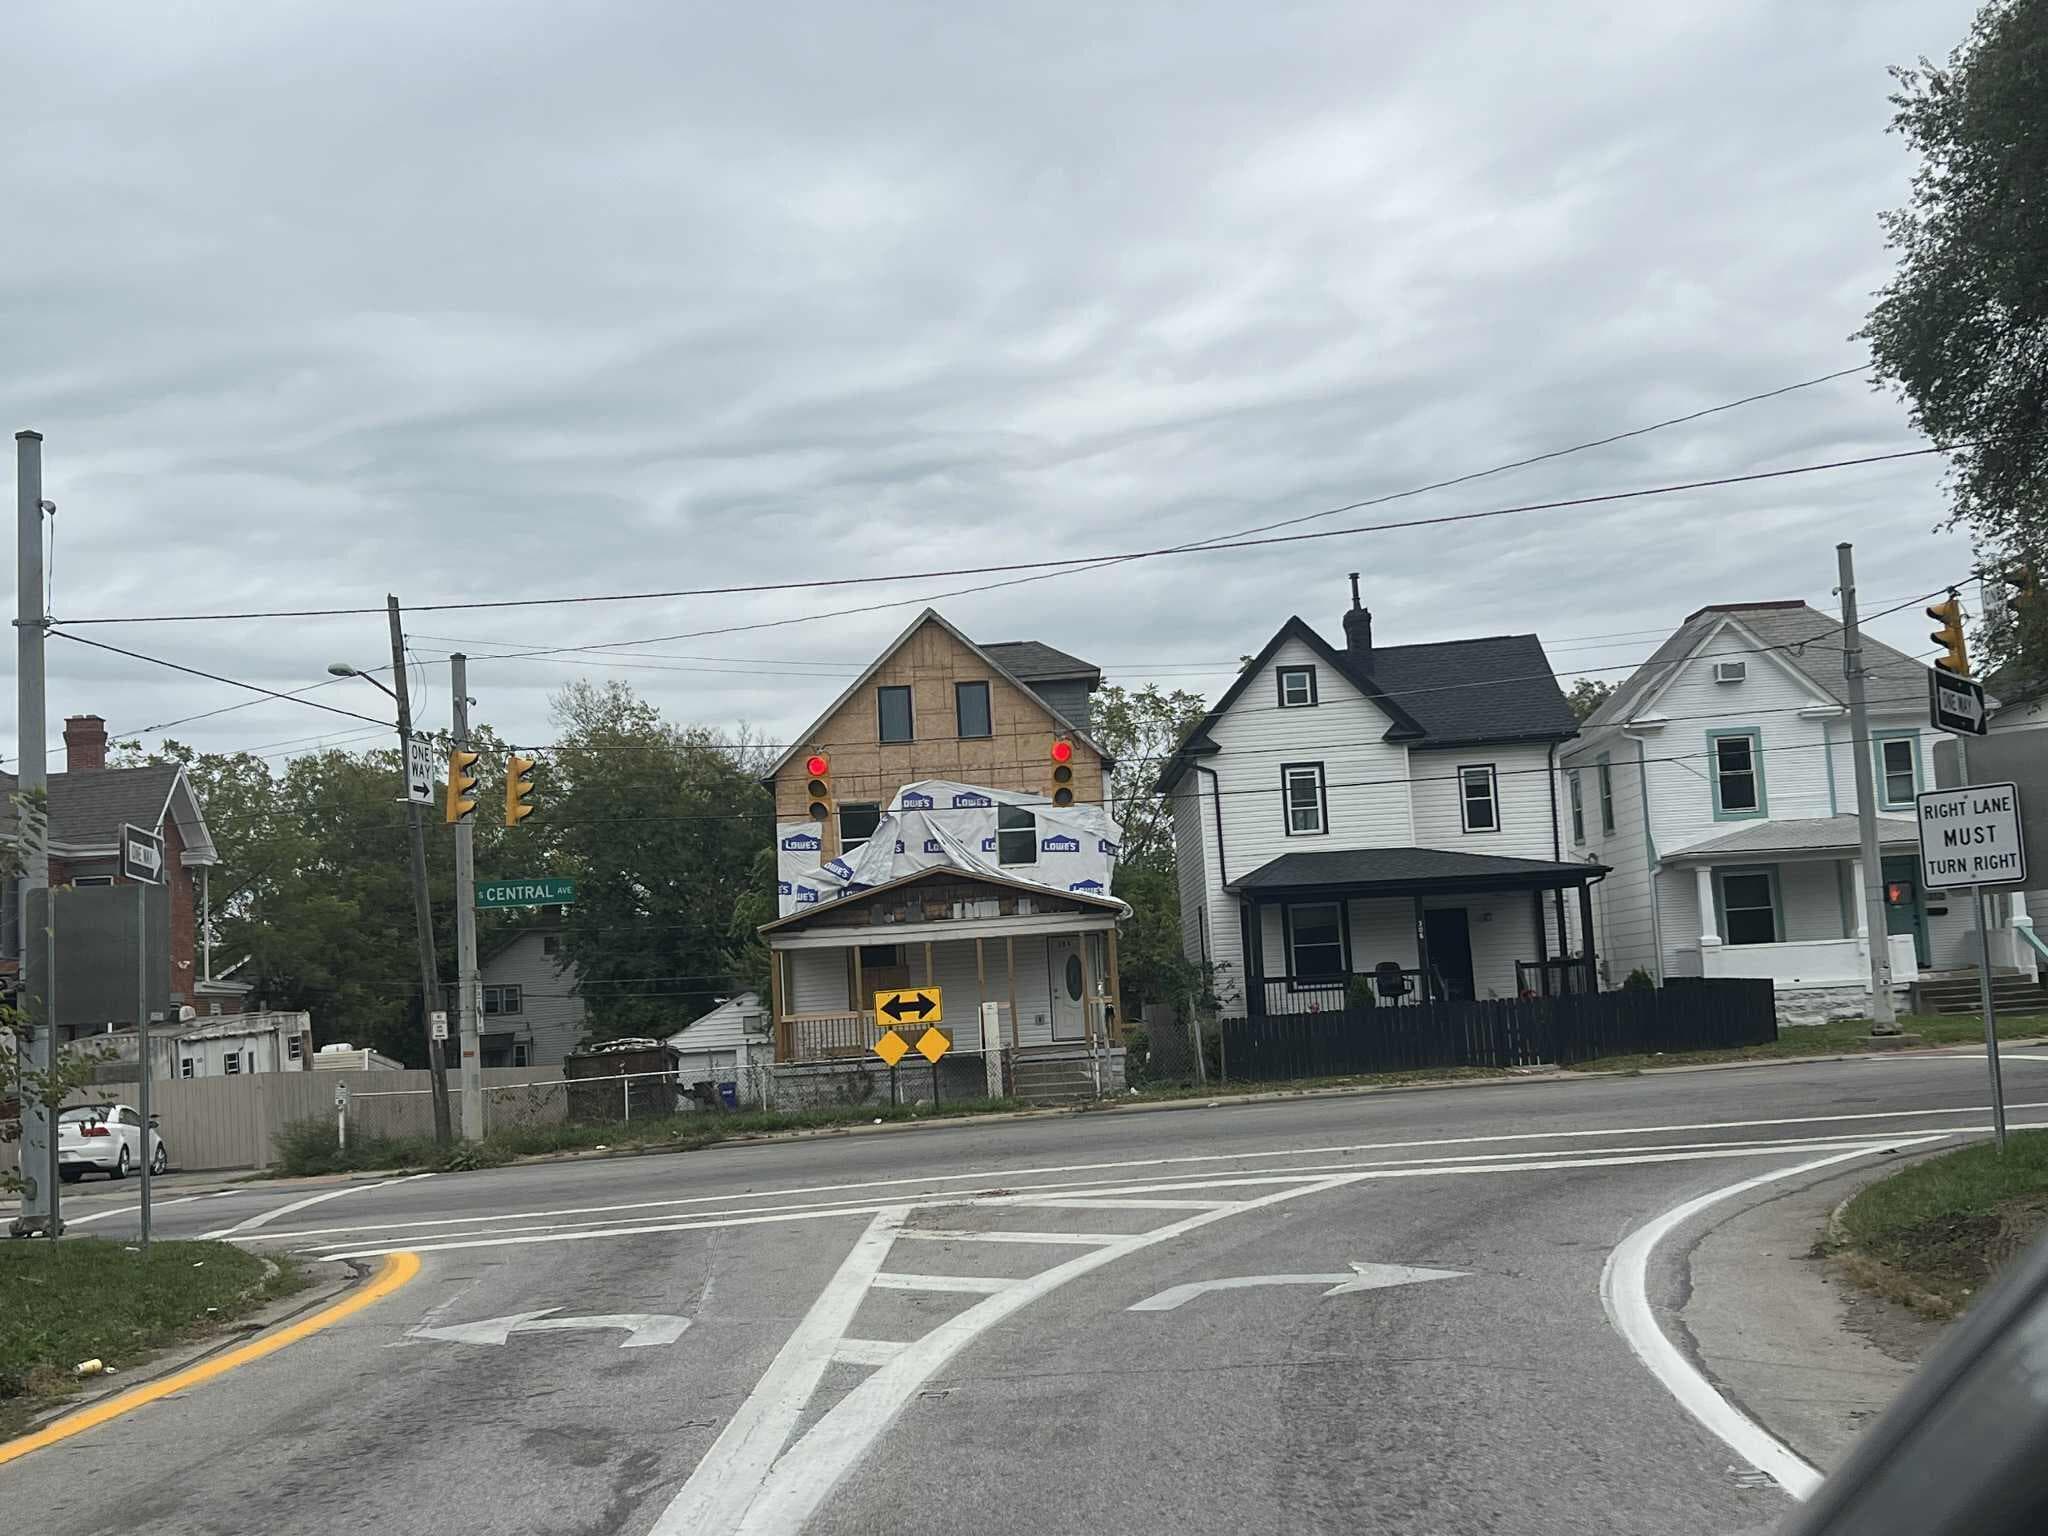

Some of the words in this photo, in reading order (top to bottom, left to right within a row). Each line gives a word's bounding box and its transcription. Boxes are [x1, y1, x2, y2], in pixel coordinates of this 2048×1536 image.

[1942, 690, 1957, 712] ONE
[411, 744, 430, 762] ONE
[411, 761, 431, 780] WAY
[903, 795, 930, 808] OWE'S
[1924, 801, 1966, 820] RIGHT
[1973, 796, 2011, 815] LANE
[785, 839, 818, 850] LOWE'S
[1943, 824, 1996, 847] MUST
[1044, 840, 1076, 851] LOWE'S
[824, 861, 850, 880] OWE'S
[1928, 857, 1967, 875] TURN
[1974, 853, 2017, 871] RIGHT
[486, 885, 554, 901] CENTRAL
[557, 886, 573, 894] AVE
